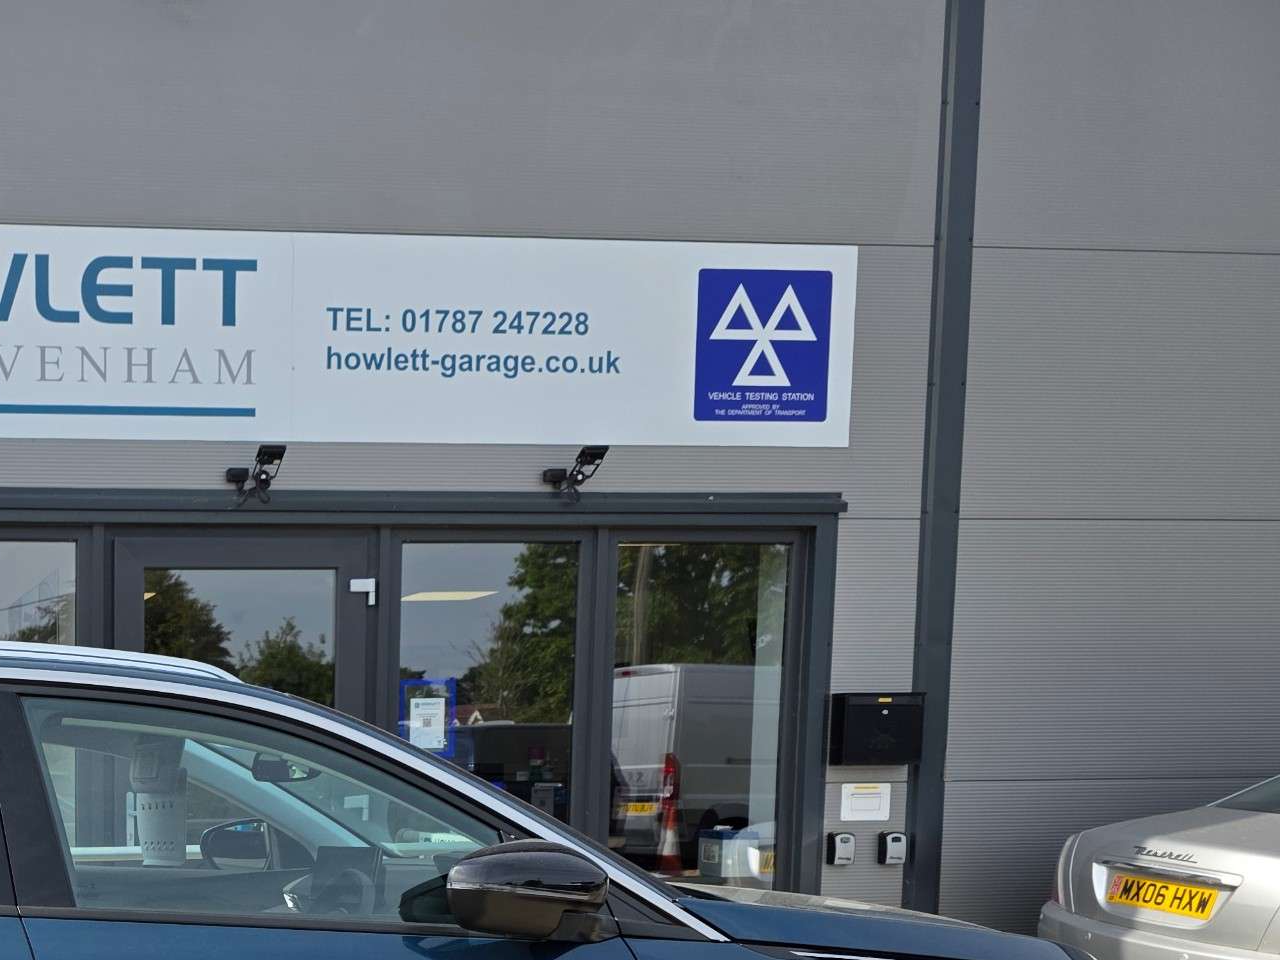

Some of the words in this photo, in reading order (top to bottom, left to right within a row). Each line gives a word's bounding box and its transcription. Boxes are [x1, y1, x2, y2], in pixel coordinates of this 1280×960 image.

[326, 307, 391, 332] TEL:
[401, 308, 484, 334] 01787
[492, 310, 589, 336] 247228
[326, 346, 620, 378] howlett-garage.co.uk
[708, 391, 742, 401] VEHICLE
[745, 392, 779, 401] TESTING
[782, 392, 815, 401] STATION
[1119, 878, 1169, 906] MX06
[1169, 887, 1213, 914] HXW
